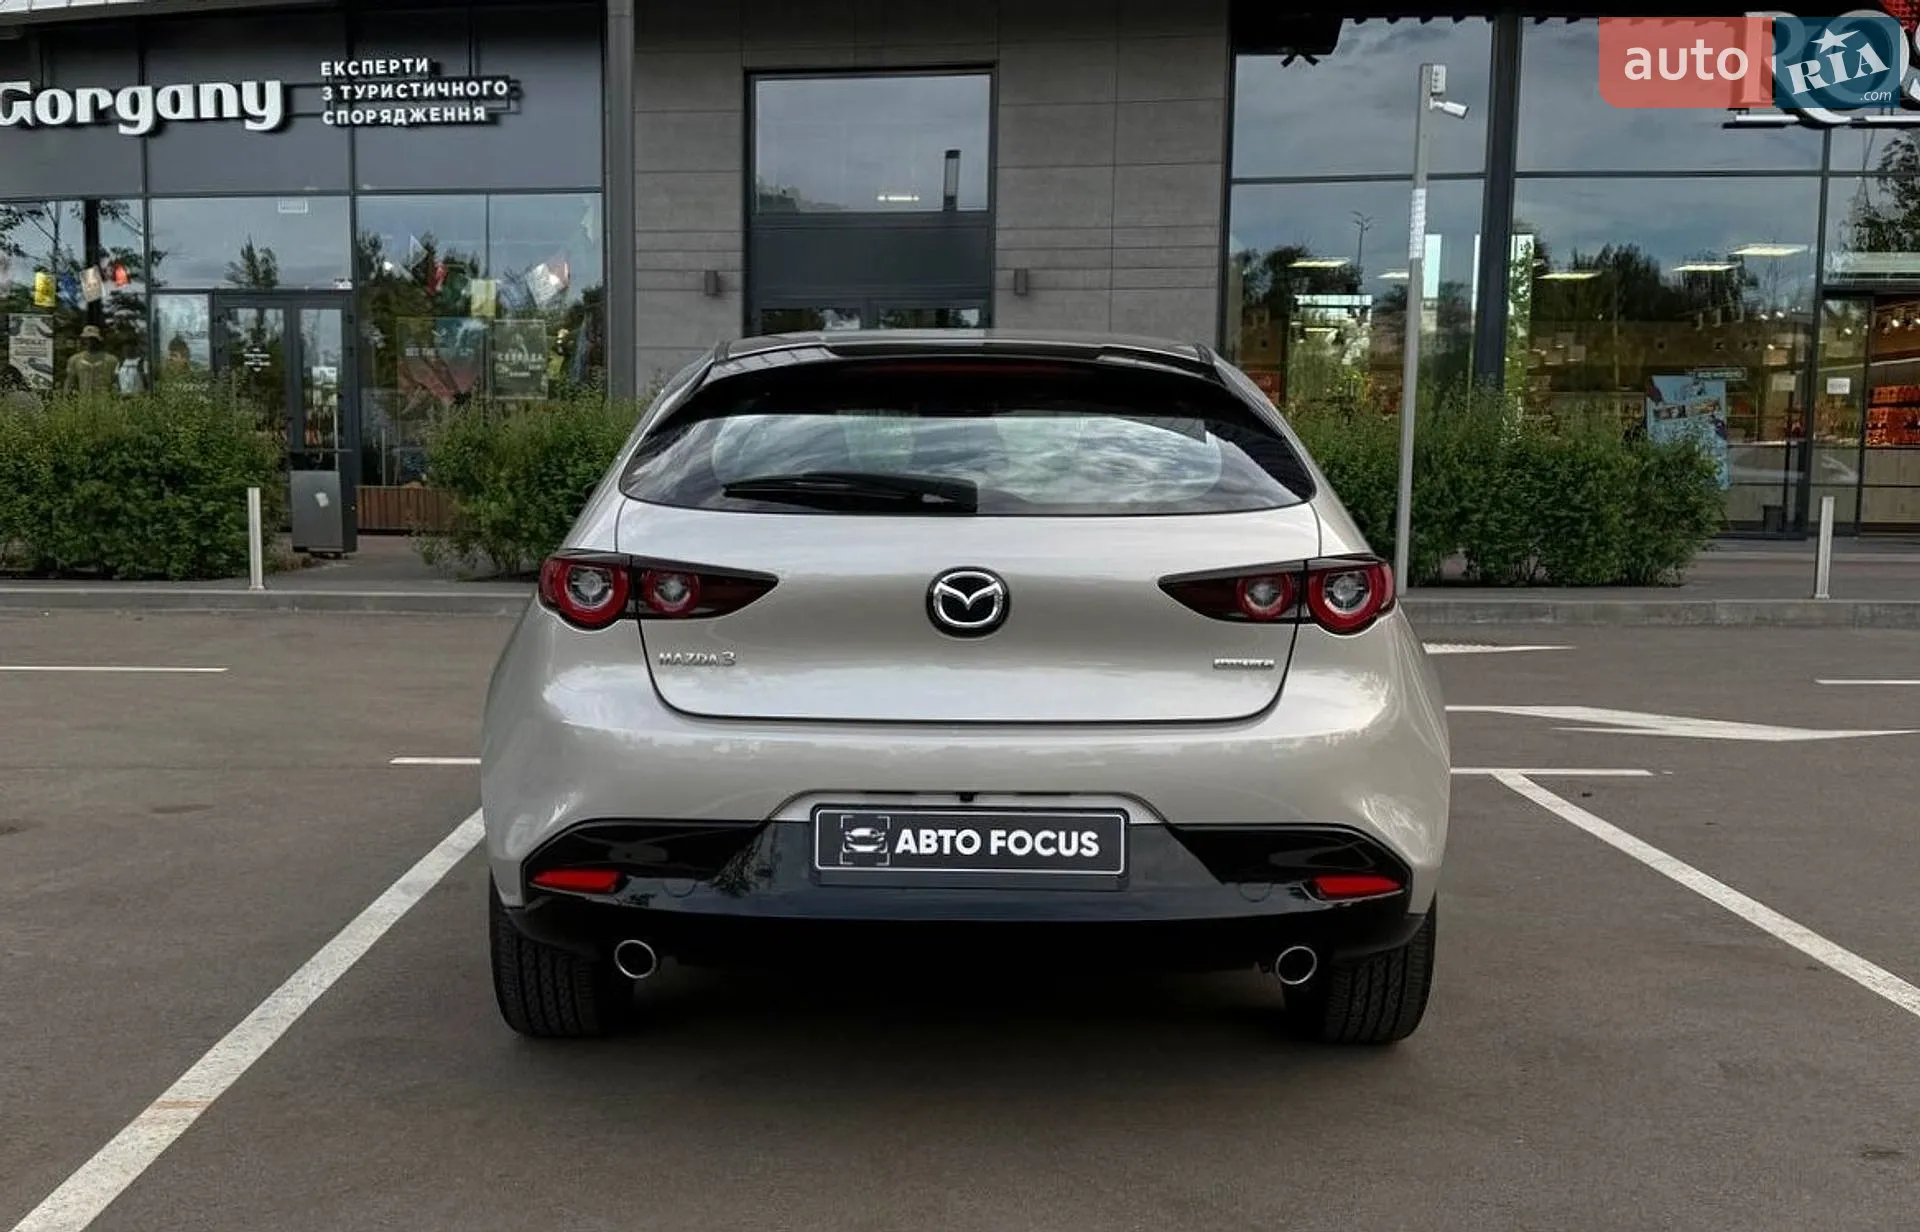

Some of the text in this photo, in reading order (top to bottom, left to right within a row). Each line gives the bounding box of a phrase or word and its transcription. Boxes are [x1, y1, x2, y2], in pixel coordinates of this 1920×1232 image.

[320, 58, 428, 76] ЕКСПЕРТИ
[340, 80, 508, 100] ТУРИСТИЧНОГО
[0, 80, 281, 135] Gorgany
[322, 106, 486, 125] СПОРЯДЖЕННЯ
[894, 828, 1101, 857] АВТО FOCUS
